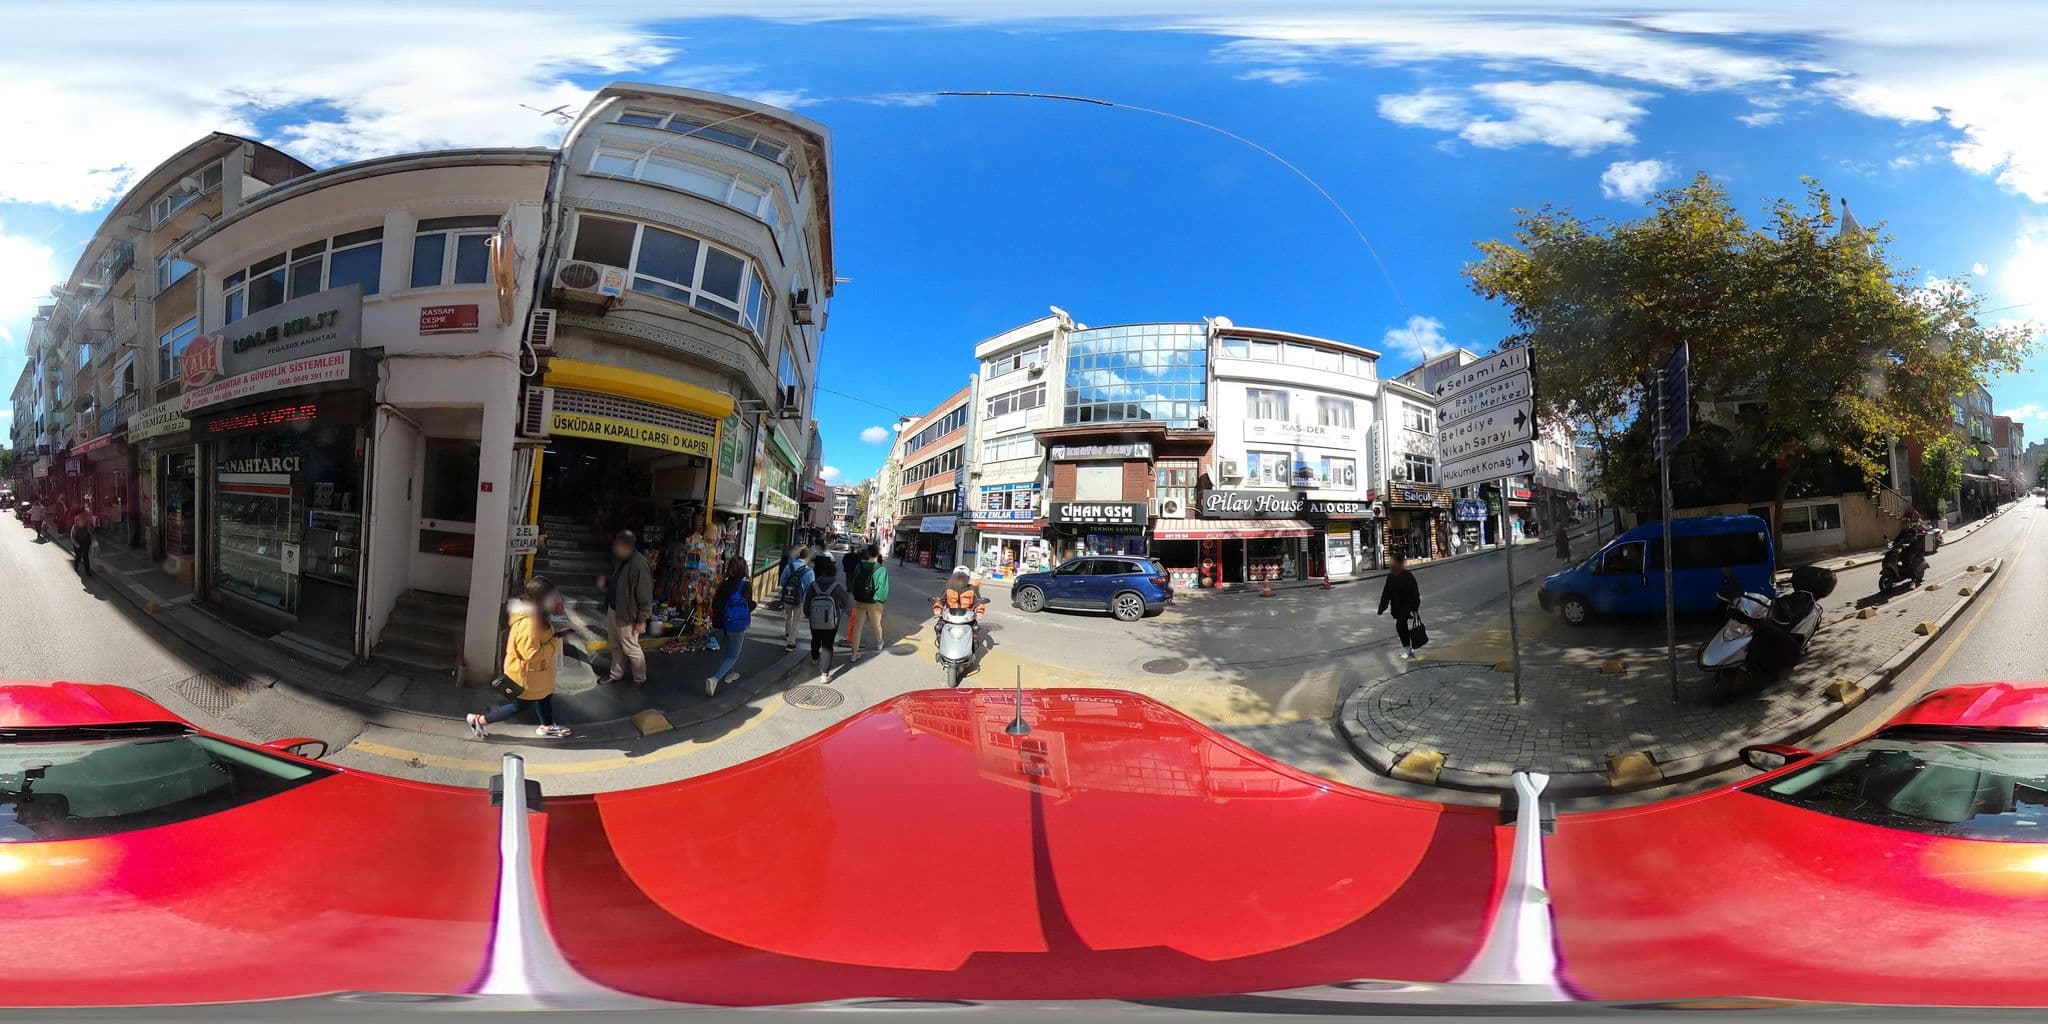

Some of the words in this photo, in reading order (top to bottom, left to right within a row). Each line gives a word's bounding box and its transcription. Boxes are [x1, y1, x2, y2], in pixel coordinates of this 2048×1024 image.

[268, 341, 299, 354] PEGASUS
[300, 333, 338, 347] ANAHTAR
[182, 343, 216, 378] KALE
[289, 353, 345, 374] SİSTEMLERİ
[1447, 364, 1495, 392] Selami
[1499, 354, 1521, 371] Ali
[1455, 381, 1515, 408] Bağlarbaşı
[1480, 388, 1526, 409] Merkezi
[553, 415, 602, 435] ÜSKÜDAR
[603, 424, 639, 440] KAPALI
[641, 429, 669, 447] ÇARŞI
[673, 435, 680, 447] D
[681, 437, 709, 455] KAPISI
[1441, 417, 1494, 443] Belediye
[1442, 441, 1471, 458] Nikah
[1473, 430, 1511, 448] Sarayı
[225, 457, 300, 472] ANAHTARCI
[1443, 463, 1481, 481] Hükümet
[1481, 457, 1514, 472] Konağı
[1206, 492, 1252, 513] Pilav
[1255, 495, 1304, 513] House
[1310, 502, 1335, 513] ALO
[1337, 502, 1359, 513] CEP
[1404, 491, 1433, 504] Selçuk
[988, 511, 1012, 519] EMLAK
[1061, 502, 1102, 518] CİHAN
[1104, 505, 1133, 518] GSM
